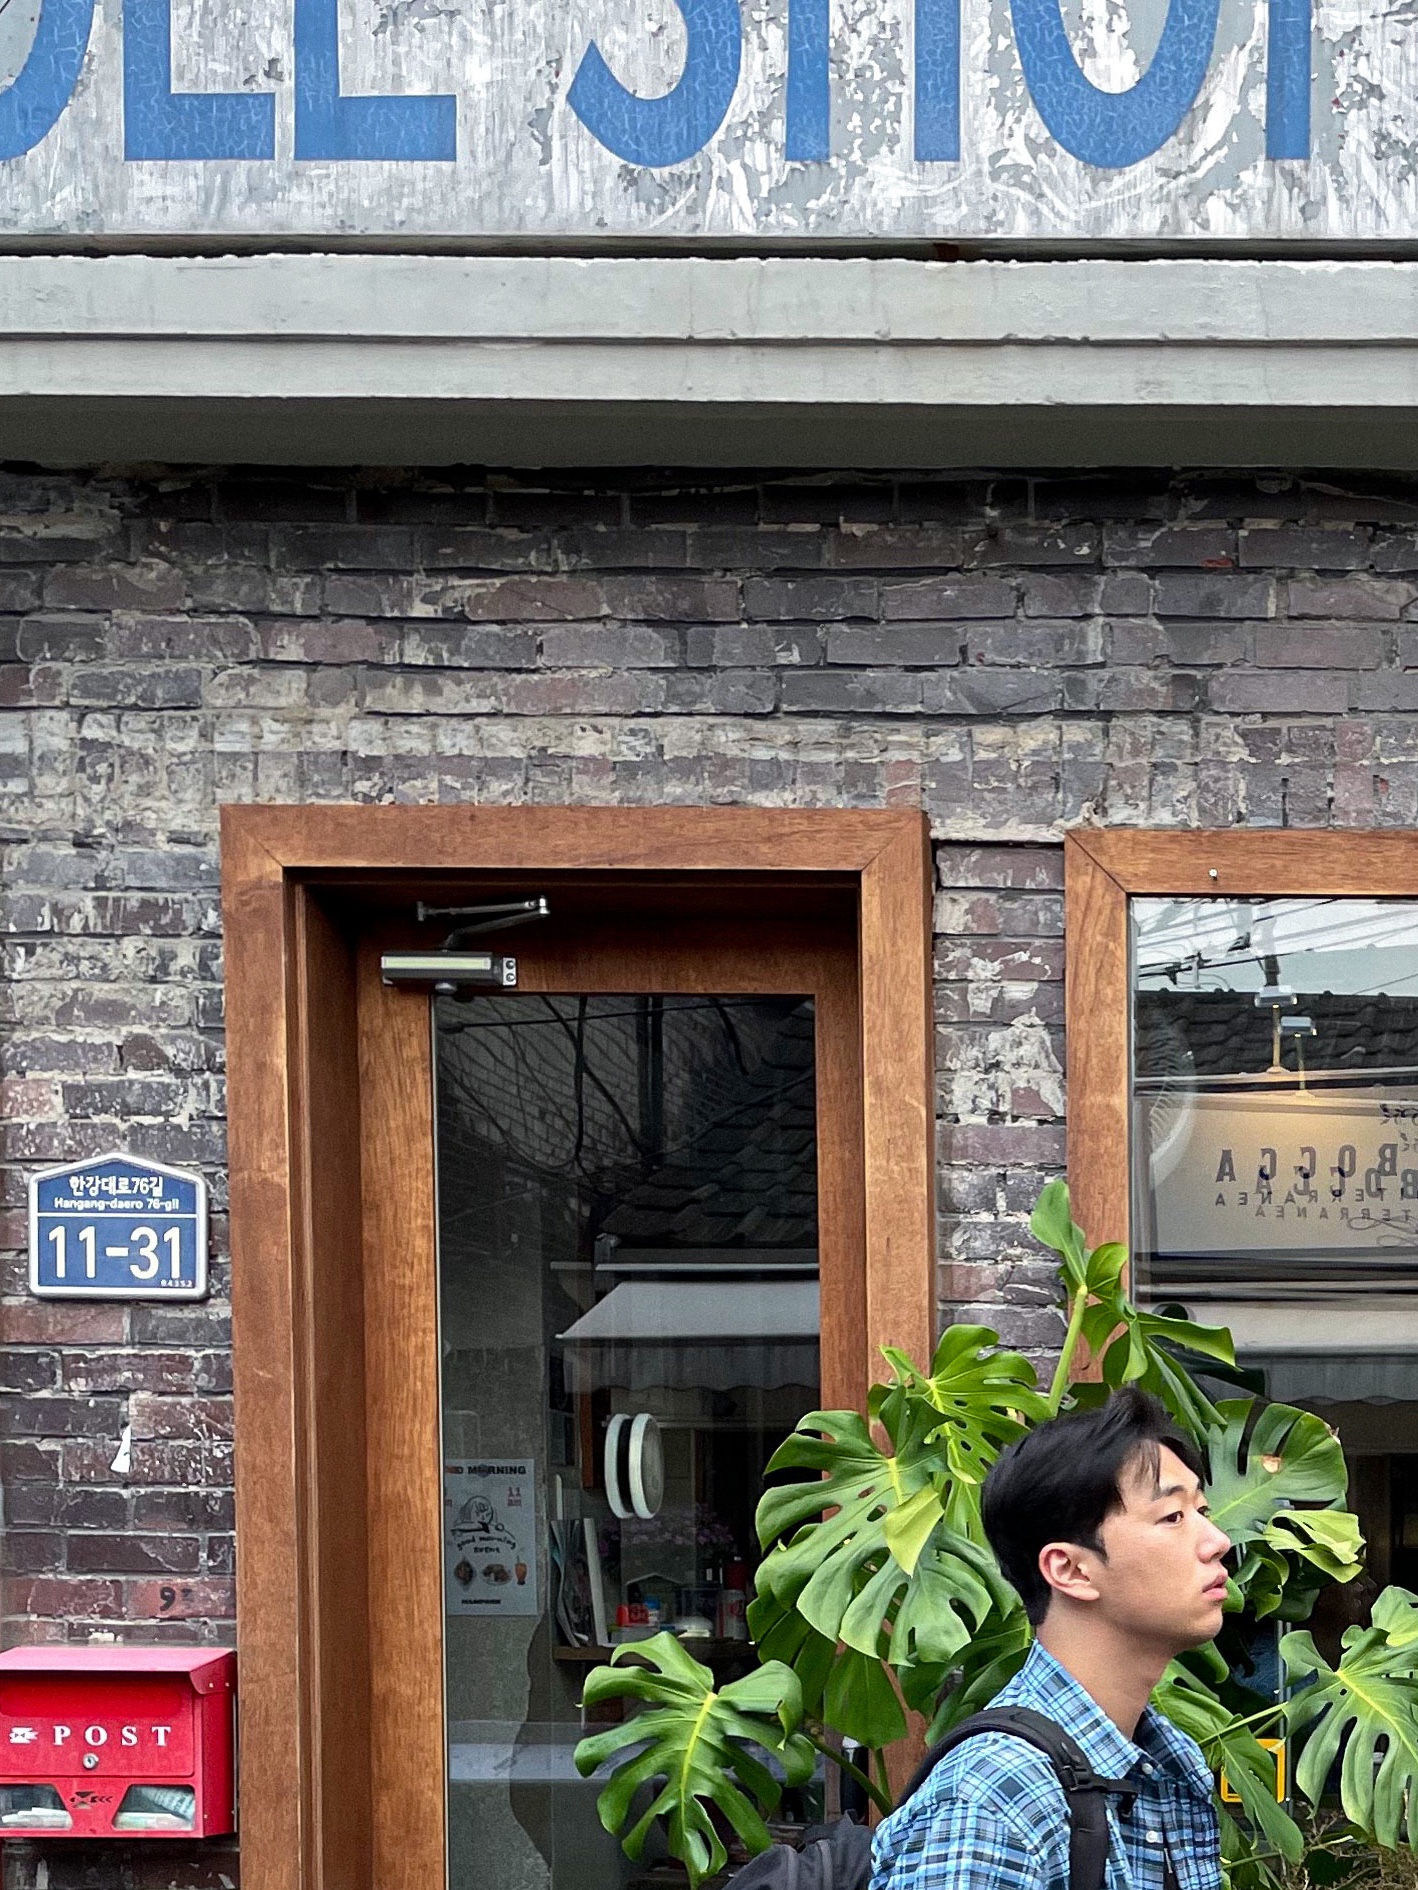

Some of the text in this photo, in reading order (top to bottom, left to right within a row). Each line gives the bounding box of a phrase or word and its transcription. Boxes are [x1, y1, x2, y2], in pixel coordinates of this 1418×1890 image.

[69, 1175, 163, 1197] 한강대로76길
[54, 1197, 180, 1212] Hangang-daero 76-gil
[48, 1225, 181, 1280] 11-31
[53, 1725, 172, 1746] POST
